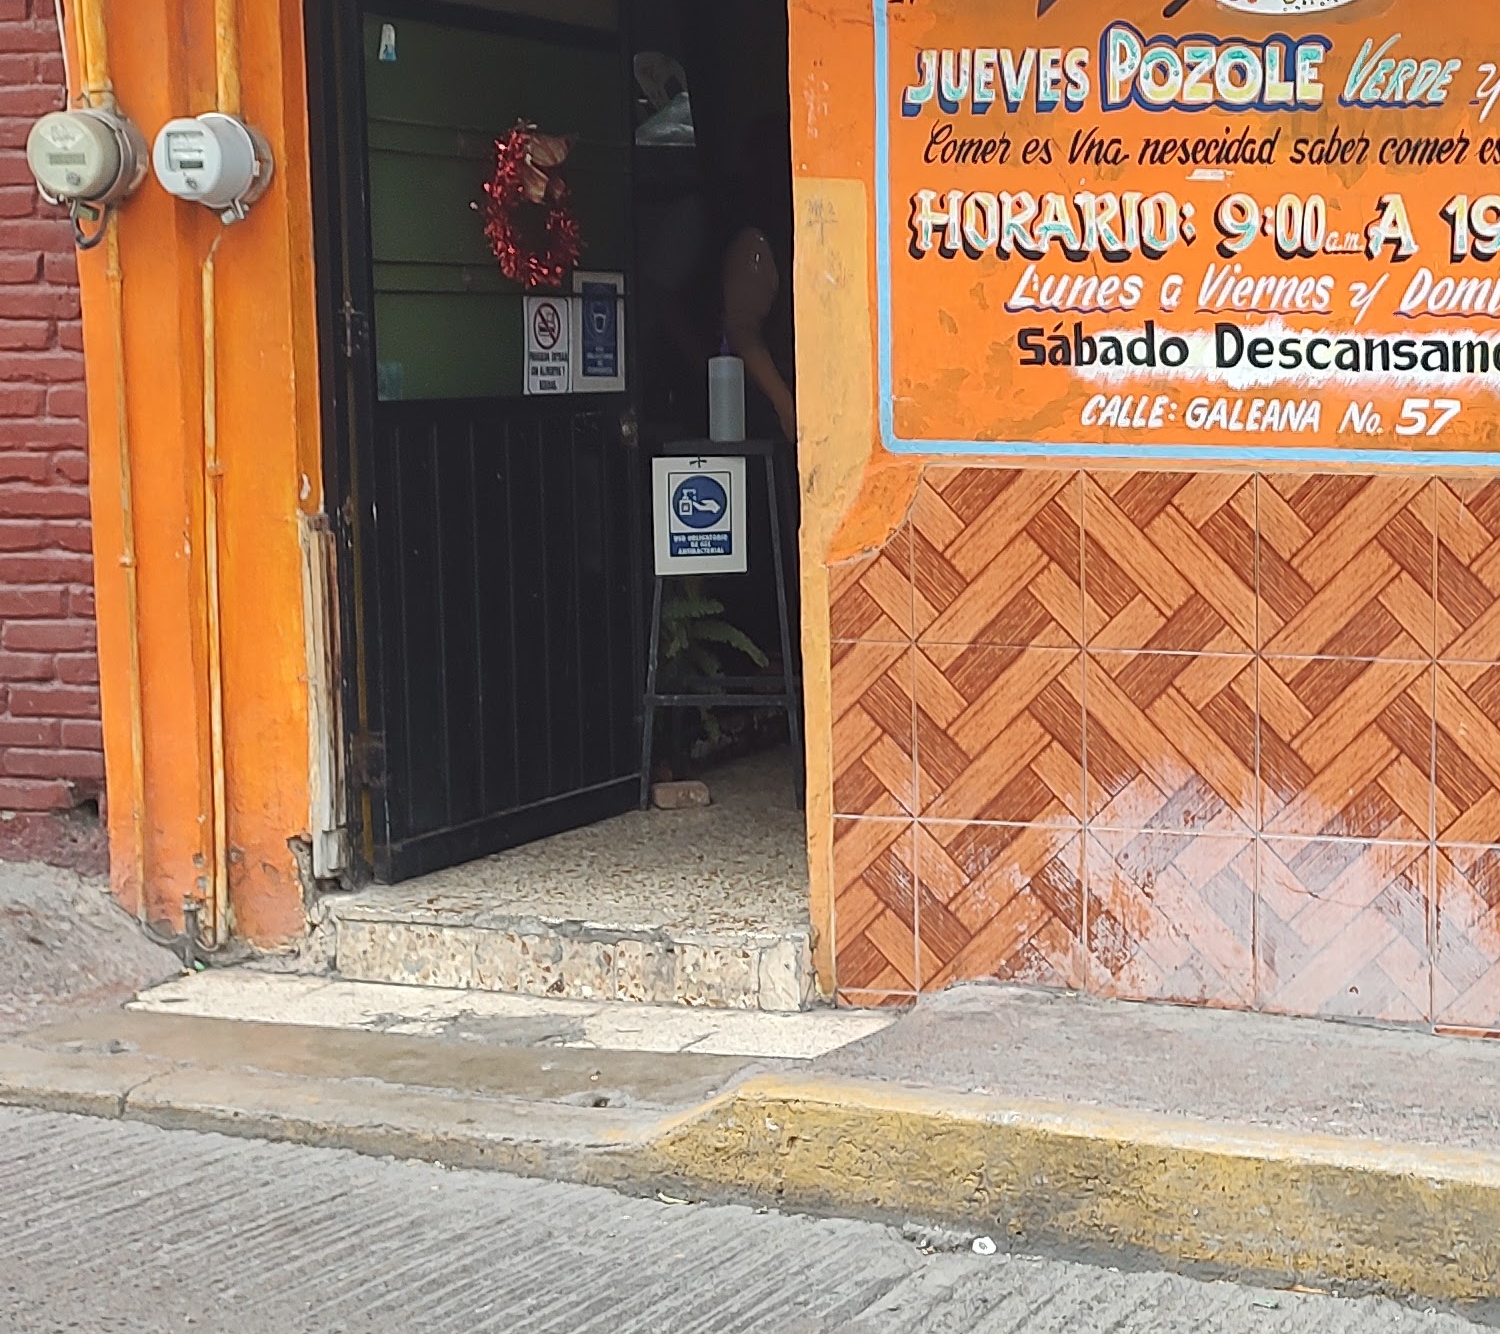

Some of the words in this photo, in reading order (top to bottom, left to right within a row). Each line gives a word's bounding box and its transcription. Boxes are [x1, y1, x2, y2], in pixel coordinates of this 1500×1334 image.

[902, 46, 1090, 115] JUEVES
[1103, 22, 1331, 111] POZOLE
[1339, 32, 1462, 107] VERDE
[923, 119, 1011, 165] Comer
[1021, 137, 1053, 165] es
[1137, 125, 1281, 166] nesecidad
[1289, 124, 1370, 166] saber
[1378, 128, 1470, 166] comer
[908, 189, 1197, 263] HORARIO:
[1213, 192, 1328, 259] 9:00
[1364, 193, 1419, 263] A
[1004, 264, 1144, 313] Lunes
[1159, 273, 1185, 312] a
[1196, 263, 1335, 315] Viernes
[1017, 319, 1190, 368] Sábado
[1080, 394, 1178, 429] CALLE:
[1184, 397, 1322, 434] GALEANA
[1395, 398, 1461, 436] 57
